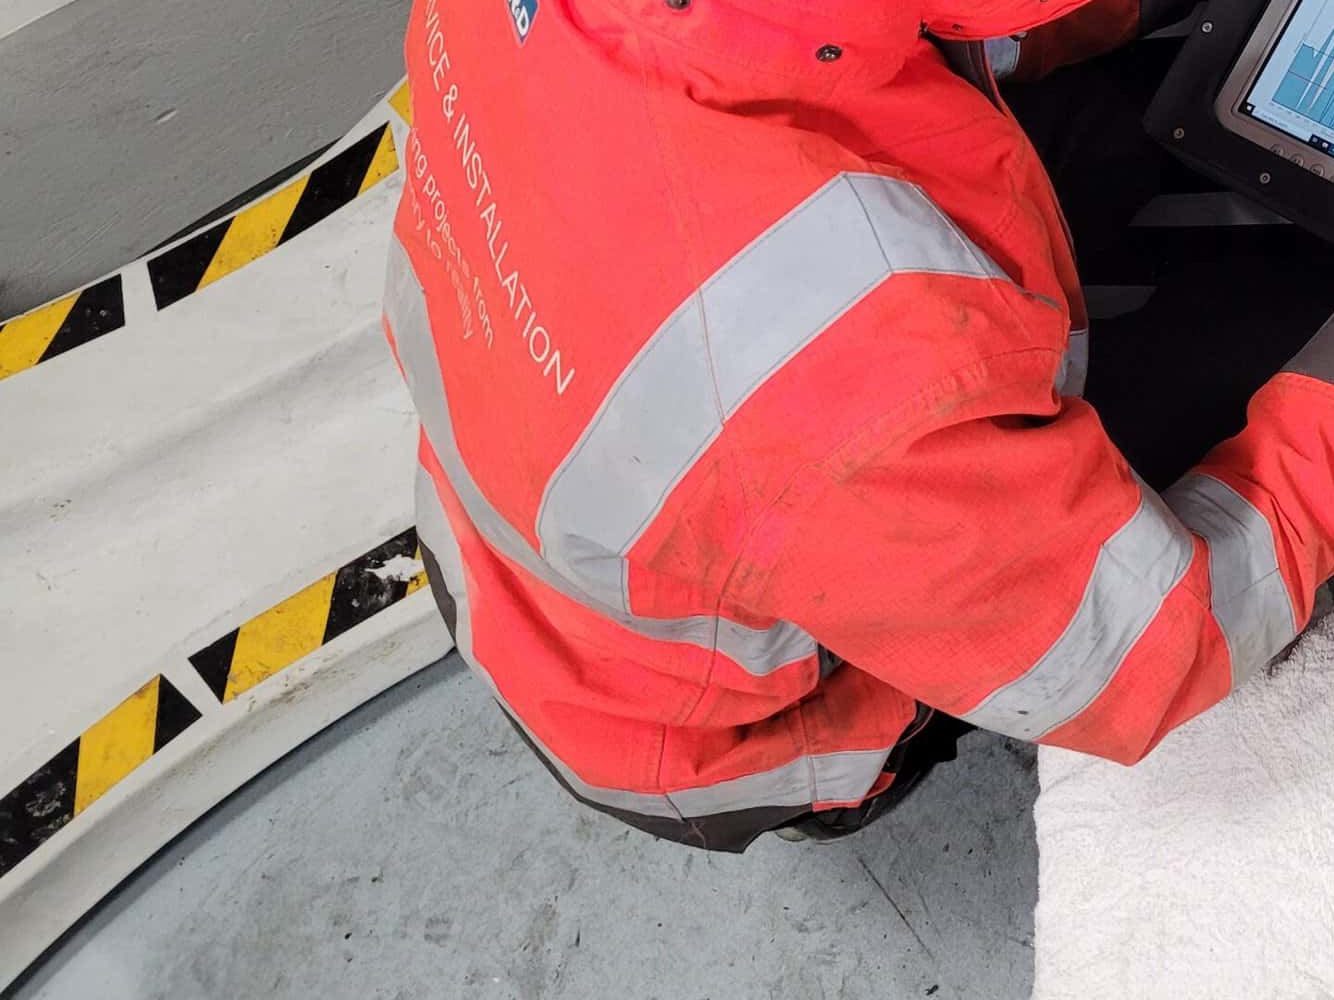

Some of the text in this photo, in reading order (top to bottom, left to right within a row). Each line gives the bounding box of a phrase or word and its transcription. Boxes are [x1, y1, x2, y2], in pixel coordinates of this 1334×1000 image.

[442, 83, 459, 123] &
[453, 112, 576, 396] INSTALLATION
[472, 276, 494, 349] from
